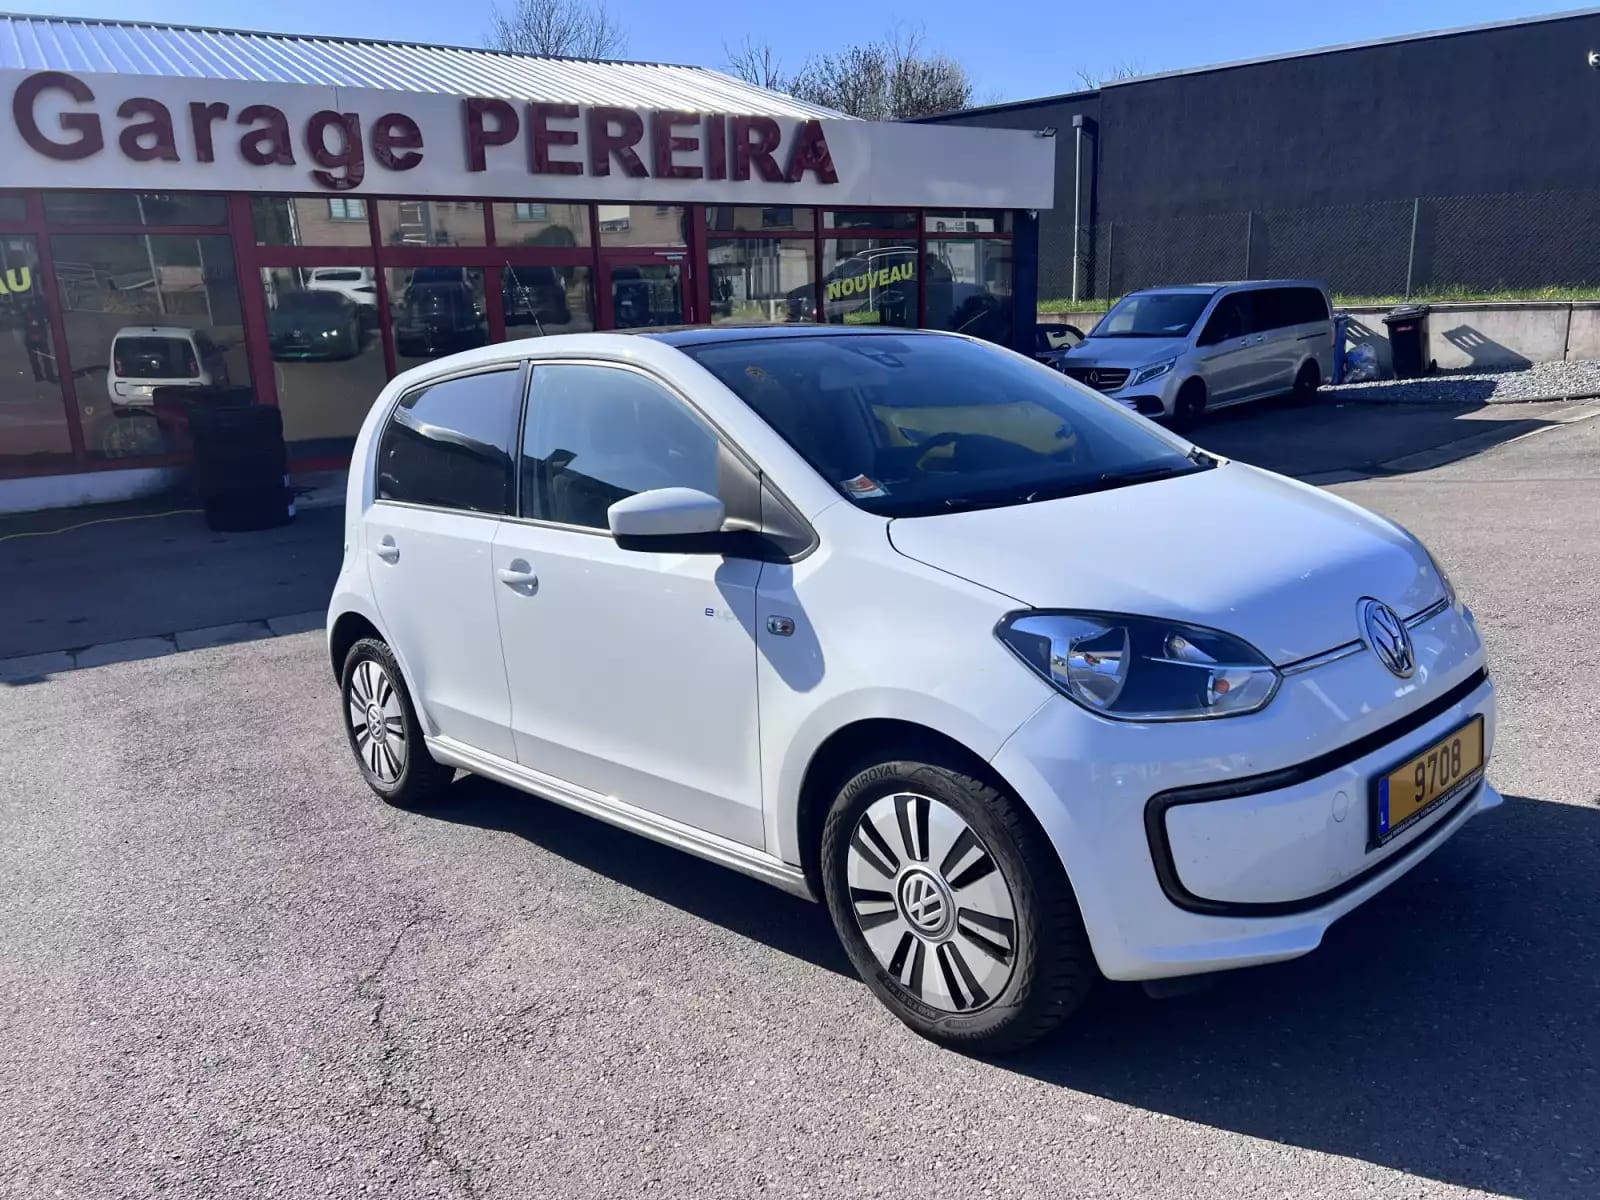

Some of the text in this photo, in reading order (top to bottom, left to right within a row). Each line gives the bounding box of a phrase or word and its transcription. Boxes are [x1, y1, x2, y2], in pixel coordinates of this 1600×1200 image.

[12, 70, 839, 190] Garage PEREIRA
[827, 261, 914, 301] NOUVEAU
[843, 764, 902, 801] UNIROYAL
[1414, 738, 1462, 803] 9708
